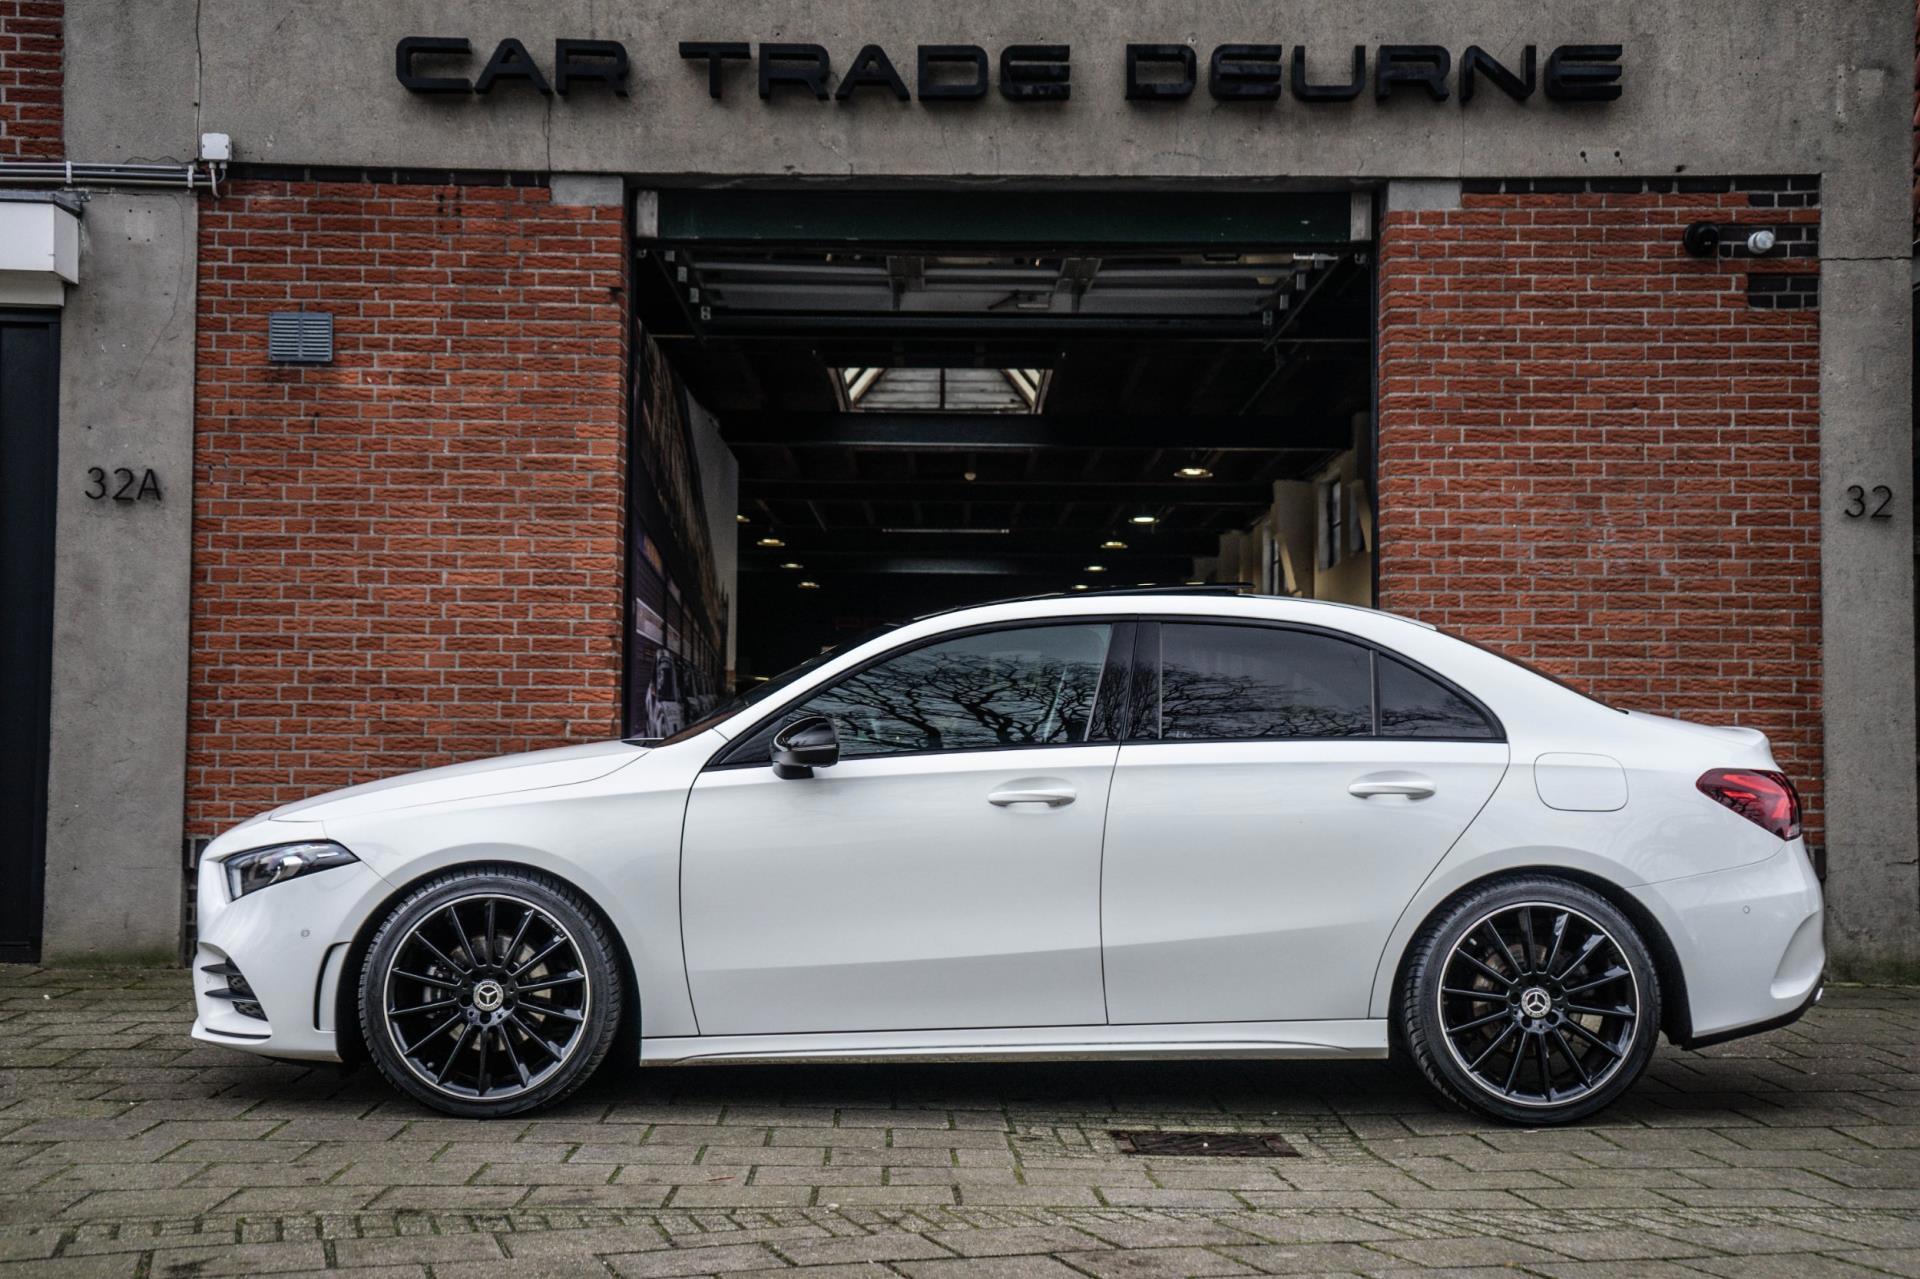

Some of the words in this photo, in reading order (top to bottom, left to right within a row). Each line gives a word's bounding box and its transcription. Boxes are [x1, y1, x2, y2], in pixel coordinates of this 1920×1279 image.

[396, 37, 630, 97] CAR
[679, 42, 1071, 101] TRADE
[1126, 44, 1622, 101] DEURNE
[85, 467, 161, 500] 32A
[1844, 485, 1892, 519] 32
